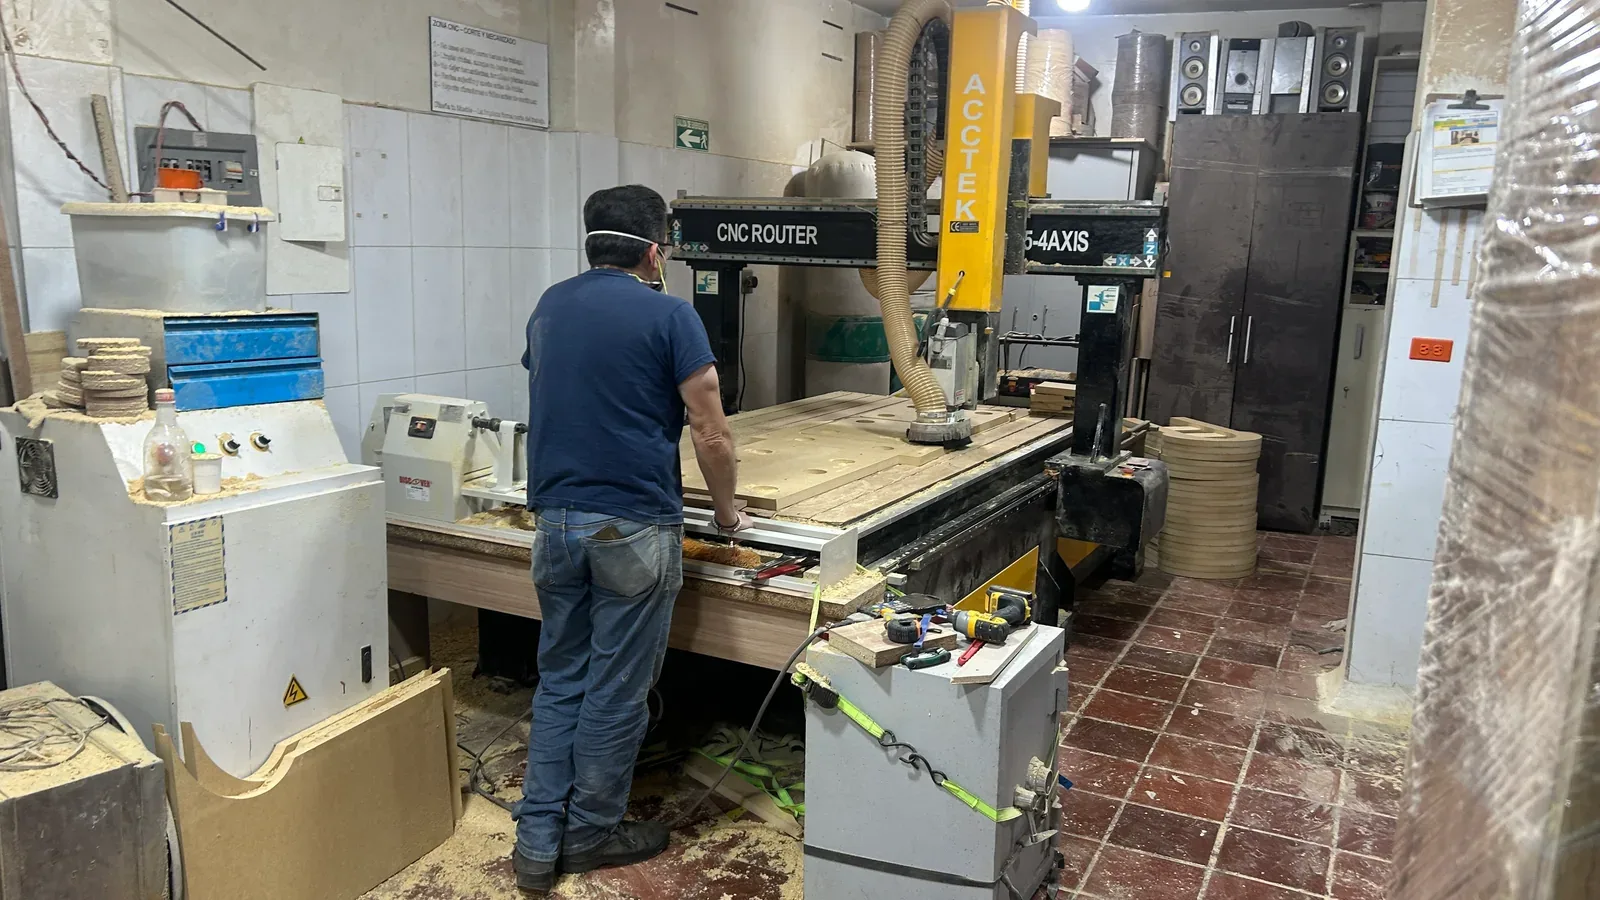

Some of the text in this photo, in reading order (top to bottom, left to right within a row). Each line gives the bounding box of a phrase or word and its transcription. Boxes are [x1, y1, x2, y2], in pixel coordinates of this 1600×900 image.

[432, 20, 446, 29] ZONA
[955, 73, 986, 220] ACCTEK
[717, 223, 818, 245] CNC ROUTER
[1119, 256, 1127, 266] X
